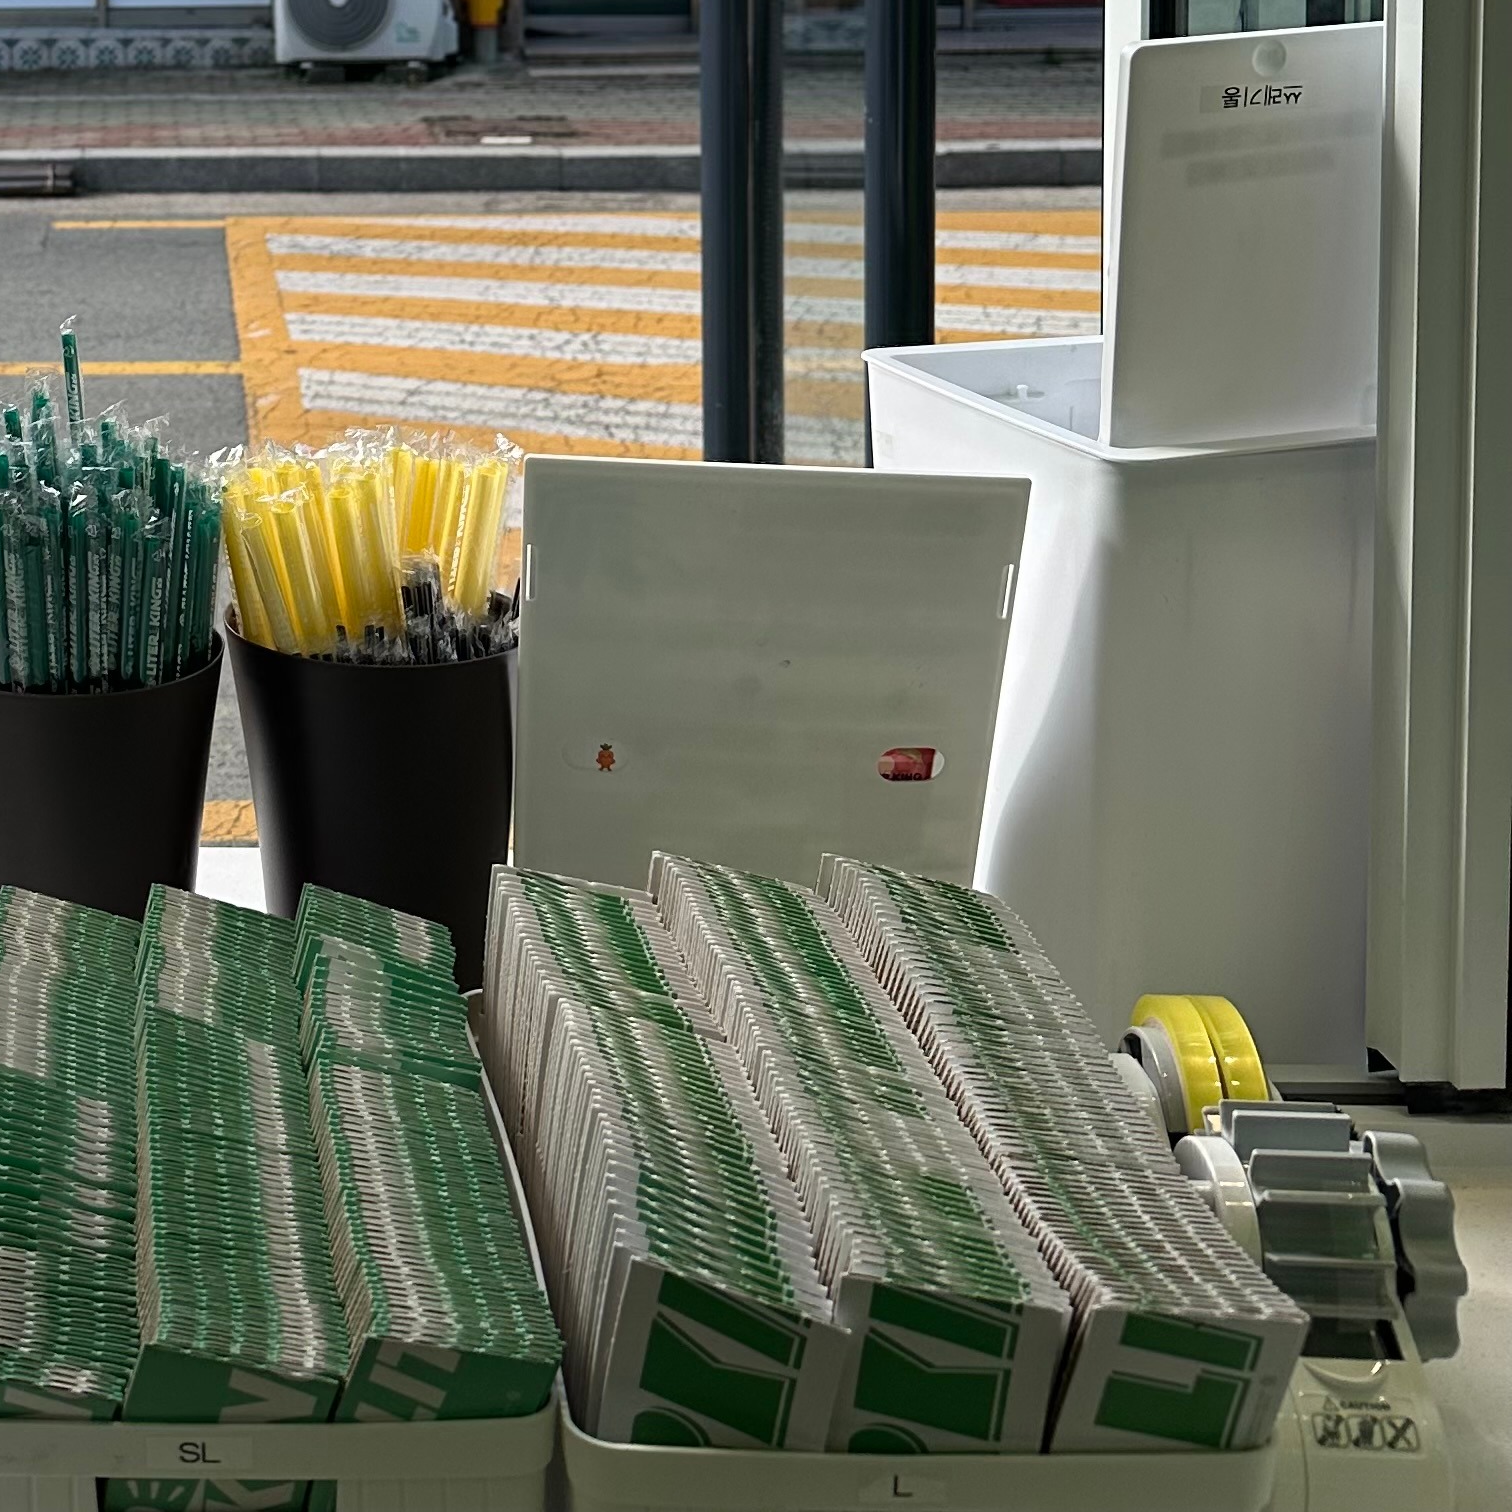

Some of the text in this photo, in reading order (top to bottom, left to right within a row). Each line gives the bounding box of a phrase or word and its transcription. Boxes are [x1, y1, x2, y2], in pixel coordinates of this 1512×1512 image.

[1222, 85, 1304, 109] 쓰레기통
[178, 1441, 221, 1465] SL
[892, 1474, 913, 1498] L
